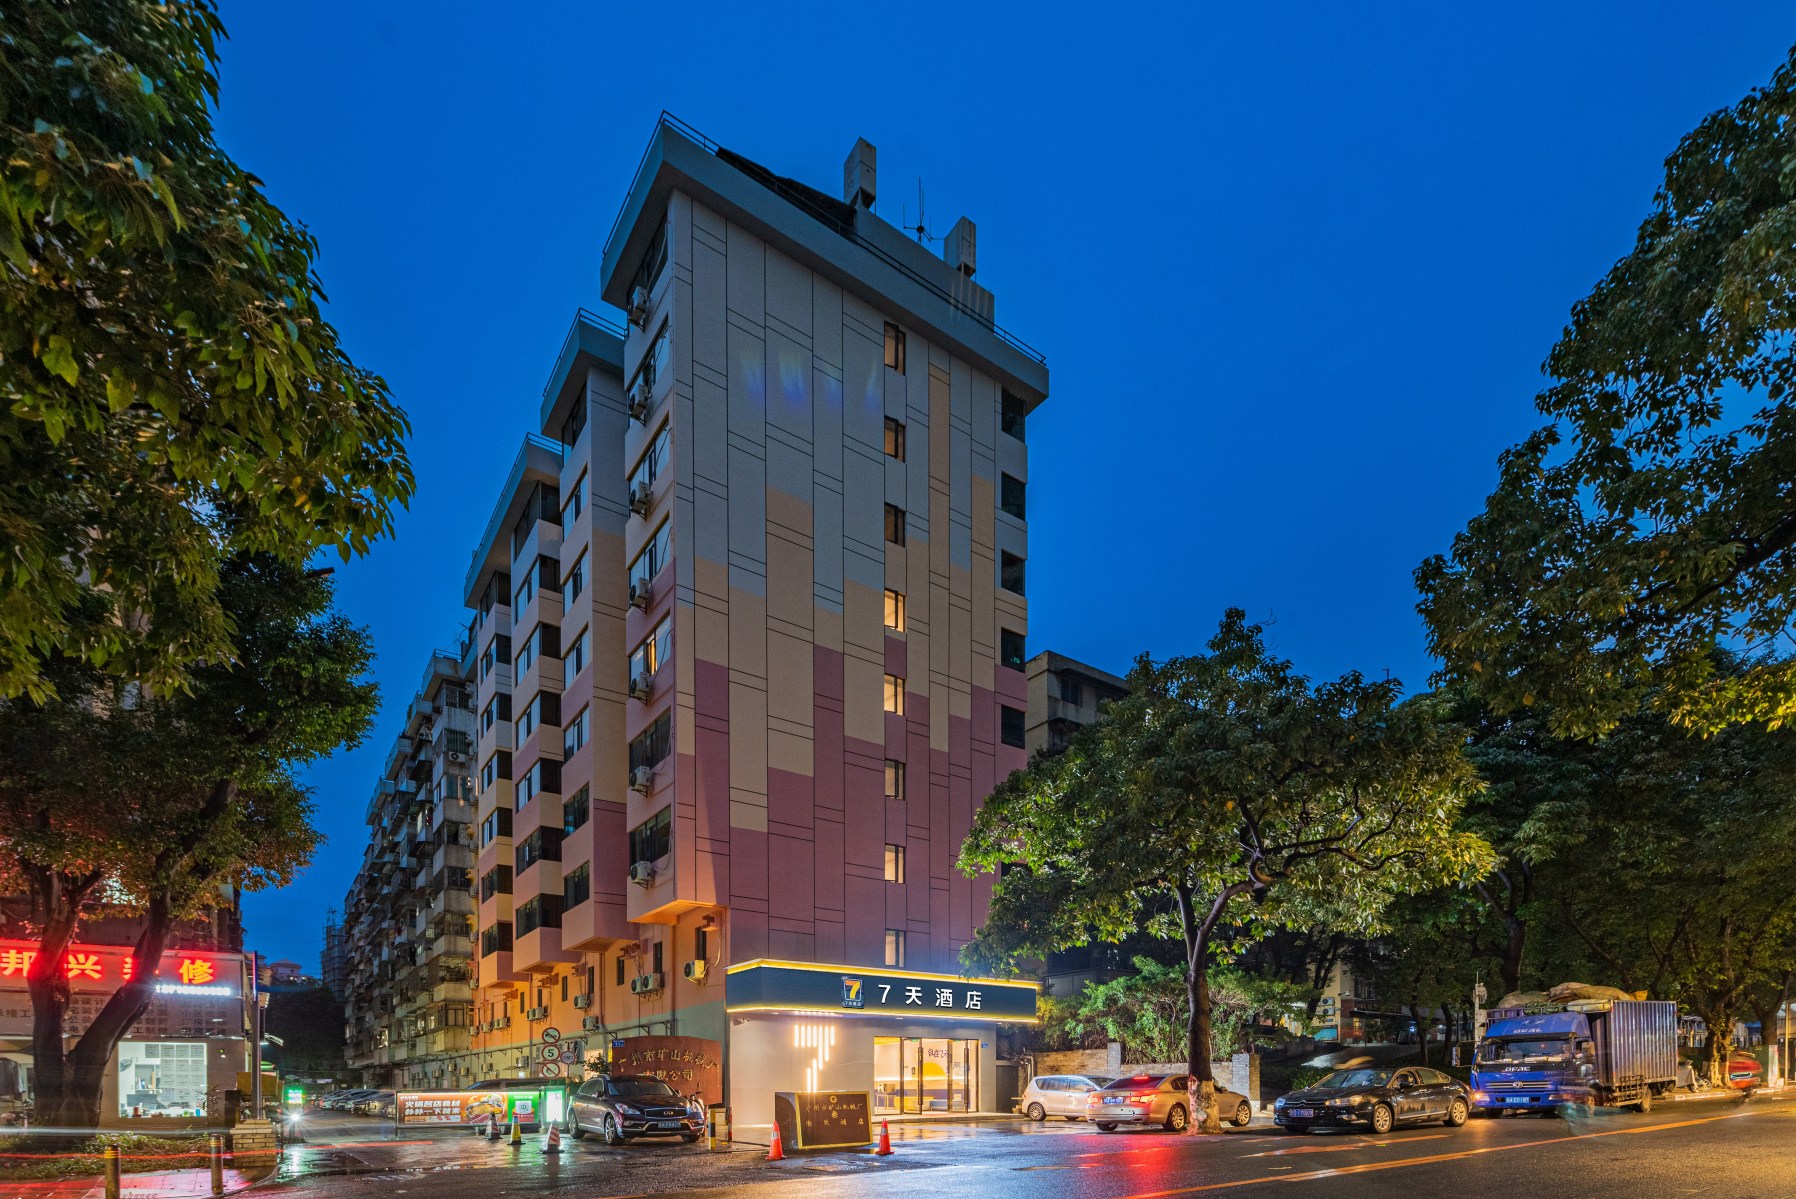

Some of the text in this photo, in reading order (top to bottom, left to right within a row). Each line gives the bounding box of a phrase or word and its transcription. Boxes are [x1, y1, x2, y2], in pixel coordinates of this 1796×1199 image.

[878, 984, 982, 1010] 7天酒店
[548, 1049, 554, 1057] 5
